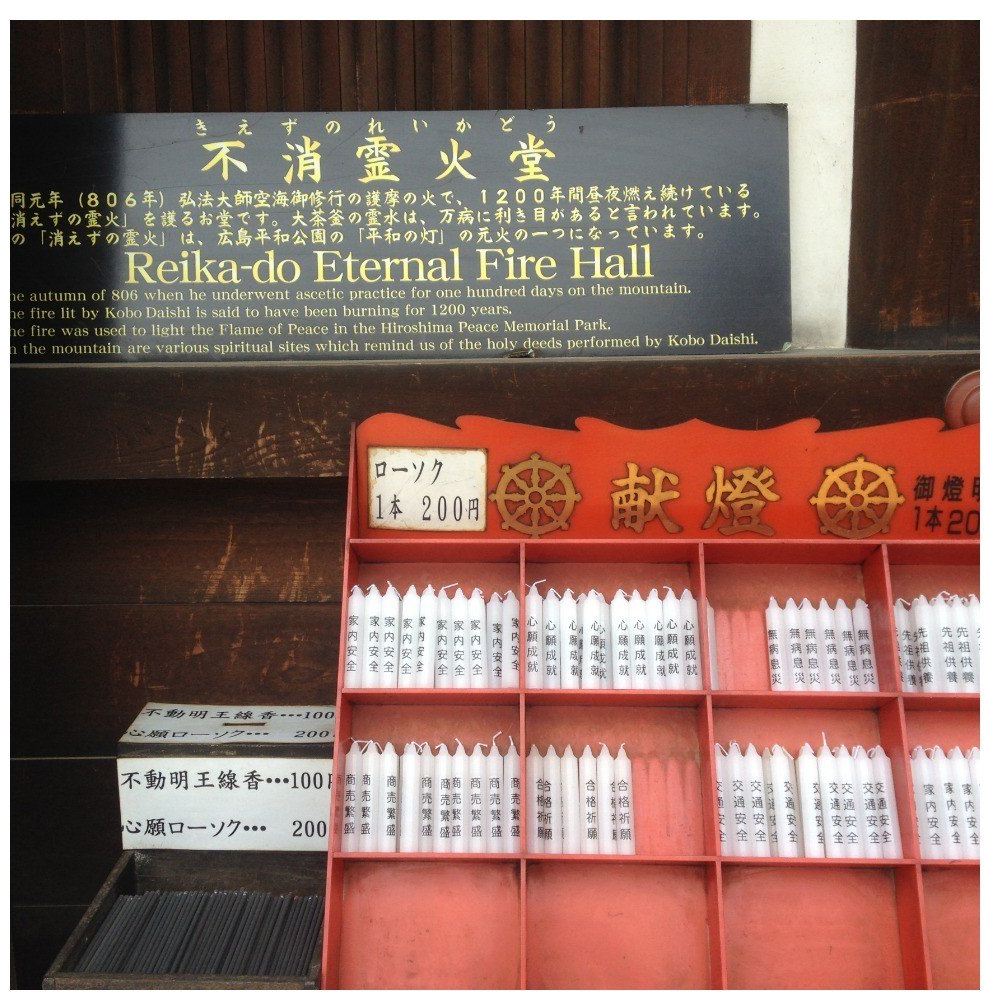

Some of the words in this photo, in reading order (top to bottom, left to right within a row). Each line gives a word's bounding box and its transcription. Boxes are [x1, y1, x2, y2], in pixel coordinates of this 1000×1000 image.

[201, 133, 556, 184] 不消霊火堂
[30, 290, 86, 302] autumn
[91, 288, 107, 301] of
[111, 289, 139, 301] 806
[144, 289, 184, 301] when
[189, 288, 207, 301] he
[212, 288, 290, 300] underwent
[296, 287, 344, 300] ascetic
[349, 287, 406, 301] practice
[410, 286, 432, 299] for
[436, 287, 462, 298] one
[467, 285, 527, 298] hundred
[531, 285, 564, 297] days
[567, 286, 586, 296] on
[591, 284, 614, 295] the
[619, 282, 692, 295] mountain.
[124, 249, 301, 285] Reika-do
[313, 247, 463, 283] Eternal
[476, 246, 558, 281] Fire
[569, 243, 655, 279] Hall
[30, 307, 56, 319] fire
[61, 307, 76, 319] lit
[82, 306, 99, 320] by
[105, 306, 142, 319] Kobo
[146, 306, 190, 318] Daishi
[196, 306, 207, 318] is
[212, 305, 240, 318] said
[245, 307, 260, 317] to
[264, 305, 299, 317] have
[304, 305, 338, 317] been
[343, 304, 400, 318] burning
[405, 303, 425, 316] for
[431, 303, 466, 316] 1200
[470, 304, 512, 317] years.
[30, 324, 56, 336] fire
[61, 327, 89, 337] was
[94, 324, 127, 337] used
[132, 325, 147, 336] to
[151, 323, 189, 338] light
[191, 324, 214, 336] the
[219, 323, 264, 335] Flame
[268, 323, 282, 335] of
[288, 323, 329, 335] Peace
[334, 322, 348, 334] in
[353, 322, 376, 334] the
[381, 321, 453, 334] Hiroshima
[458, 321, 499, 332] Peace
[504, 319, 569, 332] Memorial
[574, 318, 611, 331] Park.
[23, 343, 46, 354] the
[52, 342, 122, 354] mountain
[127, 344, 151, 354] are
[156, 342, 209, 354] various
[214, 341, 273, 355] spiritual
[278, 340, 311, 353] sites
[315, 340, 360, 352] which
[364, 339, 415, 351] remind
[419, 341, 435, 351] us
[439, 338, 454, 350] of
[459, 338, 482, 350] the
[487, 337, 518, 350] holy
[523, 337, 563, 349] deeds
[567, 336, 640, 350] performed
[645, 335, 663, 348] by
[668, 334, 706, 346] Kobo
[710, 333, 759, 346] Daishi.
[374, 458, 444, 485] ローソク
[611, 461, 782, 536] 献燈
[376, 494, 403, 520] 1本
[422, 495, 480, 521] 200円
[347, 615, 359, 672] 家内安全
[369, 616, 380, 673] 家内安全
[383, 616, 396, 673] 家内安全
[401, 618, 413, 675] 家内安全
[436, 619, 448, 676] 家内安全
[453, 620, 465, 676] 家内安全
[470, 619, 483, 676] 家内安全
[492, 623, 503, 678] 家内安全
[526, 616, 539, 673] 心願成就
[545, 620, 557, 676] 心願成就
[617, 620, 629, 676] 心願成就
[634, 619, 646, 676] 心願成就
[666, 618, 680, 675] 心願成就
[683, 620, 698, 676] 心願成就
[767, 628, 782, 685] 無病息災
[789, 628, 806, 684] 無病息災
[804, 628, 821, 684] 無病息災
[824, 629, 842, 685] 無病息災
[842, 630, 860, 687] 無病息災
[858, 629, 876, 685] 無病息災
[941, 626, 958, 684] 先祖供養
[957, 626, 975, 684] 先祖供養
[294, 730, 336, 738] 200
[292, 820, 328, 838] 200
[344, 774, 356, 834] 商売繁盛
[421, 777, 433, 837] 商売繁盛
[470, 777, 482, 837] 商売繁盛
[489, 777, 502, 838] 商売繁盛
[586, 779, 598, 840] 合格祈願
[617, 779, 632, 841] 合格祈願
[733, 780, 748, 841] 交通安全
[750, 780, 767, 841] 交通安全
[784, 781, 798, 842] 交通安全
[829, 782, 843, 844] 交通安全
[842, 782, 858, 844] 交通安全
[863, 782, 880, 843] 交通安全
[875, 782, 892, 843] 交通安全
[923, 784, 941, 845] 家内安全
[944, 782, 961, 843] 家内安全
[962, 783, 980, 845] 家内安全
